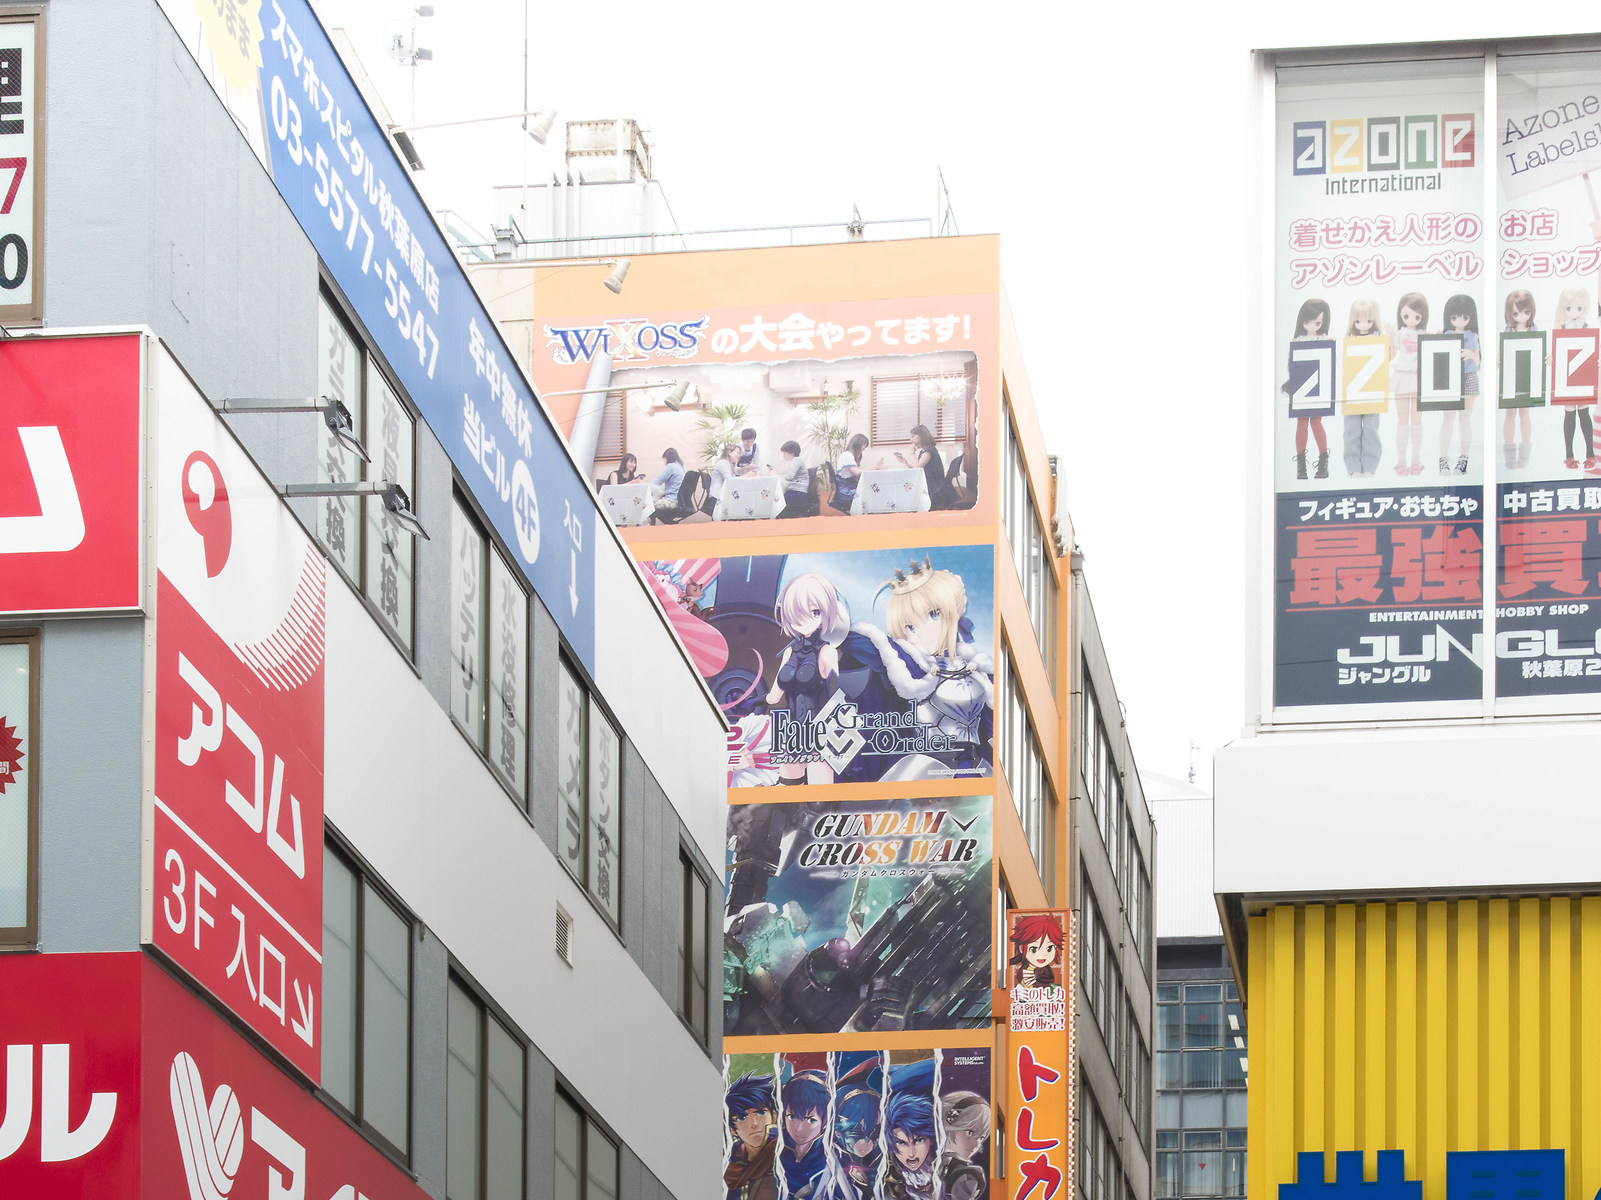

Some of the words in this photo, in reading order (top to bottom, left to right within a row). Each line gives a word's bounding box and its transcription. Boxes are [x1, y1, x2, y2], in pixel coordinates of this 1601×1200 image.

[1295, 116, 1474, 172] azone
[1502, 95, 1600, 146] Azone
[1325, 172, 1442, 196] International
[271, 74, 439, 380] 03-5577-5547
[1293, 216, 1479, 248] 着せかえ人形の
[1503, 211, 1556, 238] お店
[1295, 254, 1480, 288] アゾンレーベル
[468, 316, 533, 459] 年中無休
[462, 392, 511, 503] 当ビル
[563, 498, 582, 553] 入口
[1299, 495, 1479, 522] フィギュア・おもちゃ
[1290, 525, 1484, 605] 最強
[459, 526, 478, 724] バッテリー
[1369, 609, 1484, 623] ENTERTAINMENT
[1496, 605, 1544, 618] HOBBY
[1549, 603, 1589, 616] SHOP
[1338, 665, 1432, 685] ジャングル
[769, 708, 829, 755] Fate
[829, 697, 921, 731] Grand
[868, 722, 958, 755] Order
[178, 651, 306, 881] アコム
[565, 685, 582, 862] カメラ
[813, 811, 948, 838] GUNDAM
[799, 840, 901, 867] CROSS
[908, 838, 978, 864] WAR
[162, 847, 218, 951] 3F
[226, 903, 287, 1027] 入口
